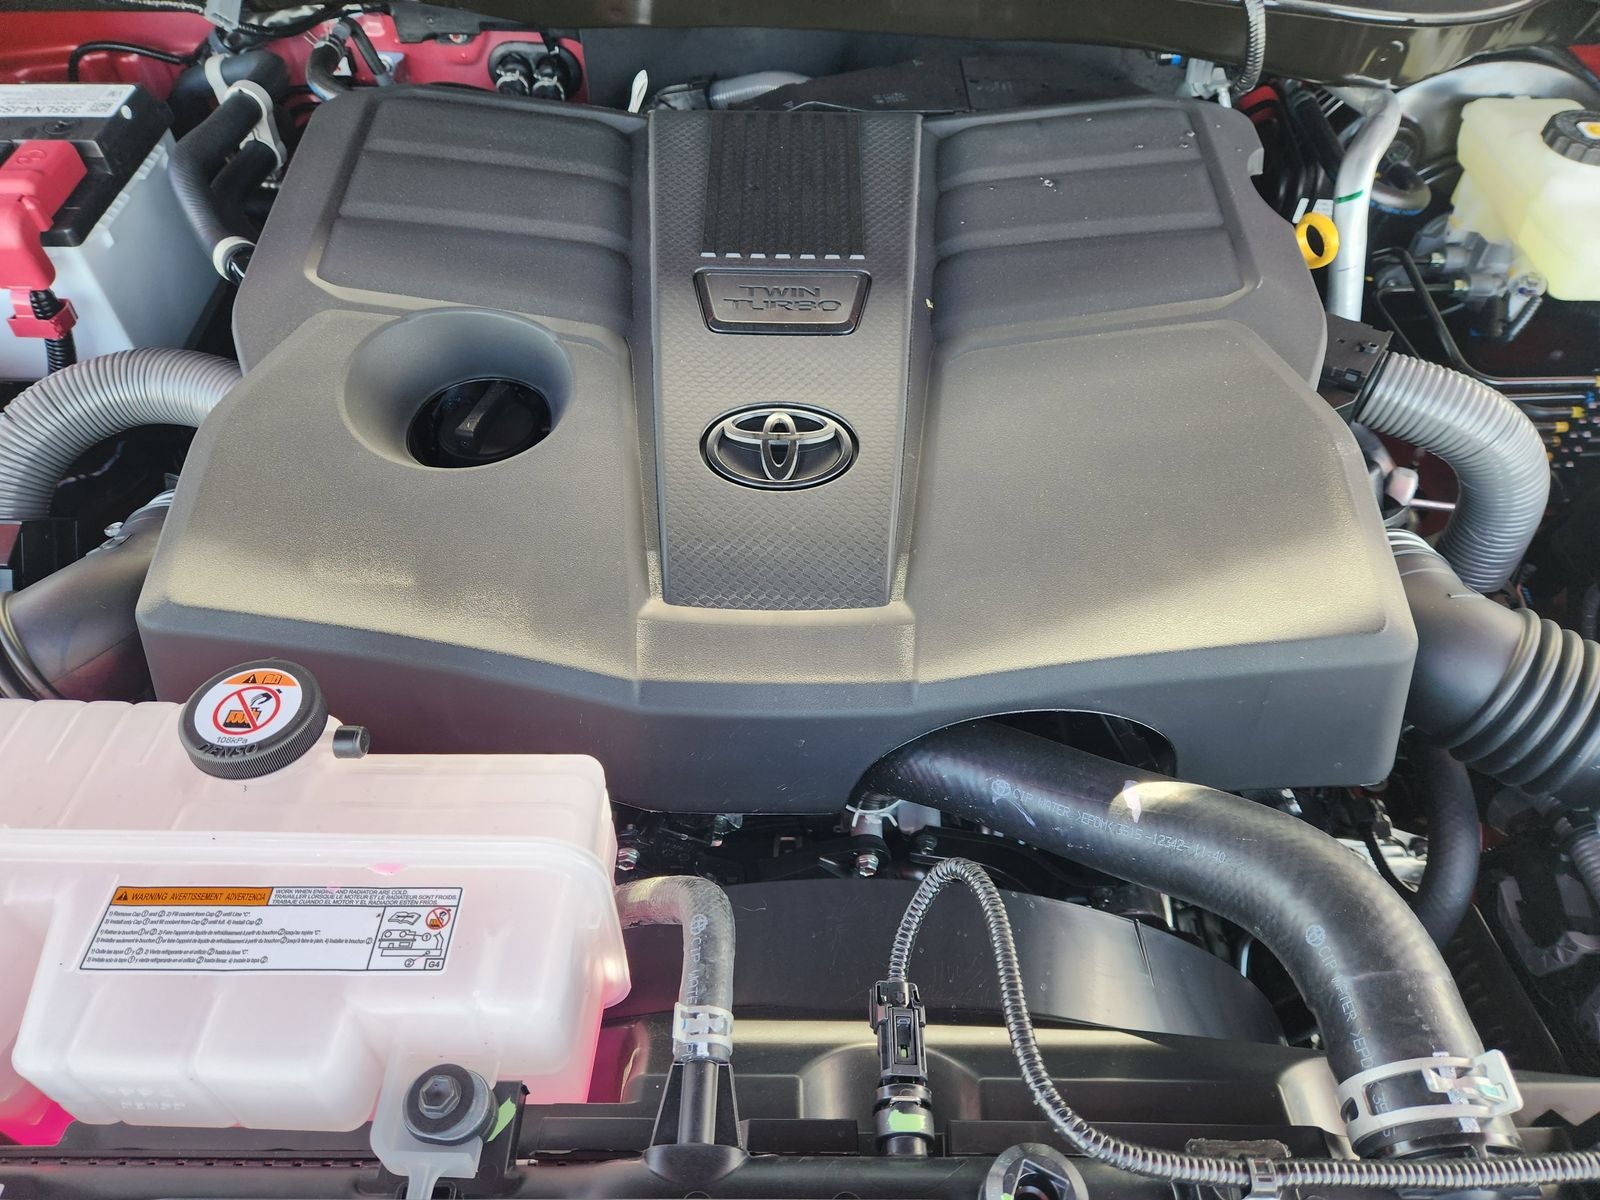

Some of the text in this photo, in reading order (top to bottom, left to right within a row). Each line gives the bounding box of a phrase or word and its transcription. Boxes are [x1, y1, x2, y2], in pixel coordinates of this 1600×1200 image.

[738, 285, 821, 297] TWIN
[722, 298, 842, 312] TURBO
[216, 736, 248, 744] 108kPa
[197, 743, 259, 758] DENSO
[1038, 797, 1072, 819] WATER
[131, 892, 266, 901] WARNING AVERTISSEMENT ADVERTENCIA
[686, 969, 700, 1005] WATE
[1331, 975, 1359, 1022] WATER
